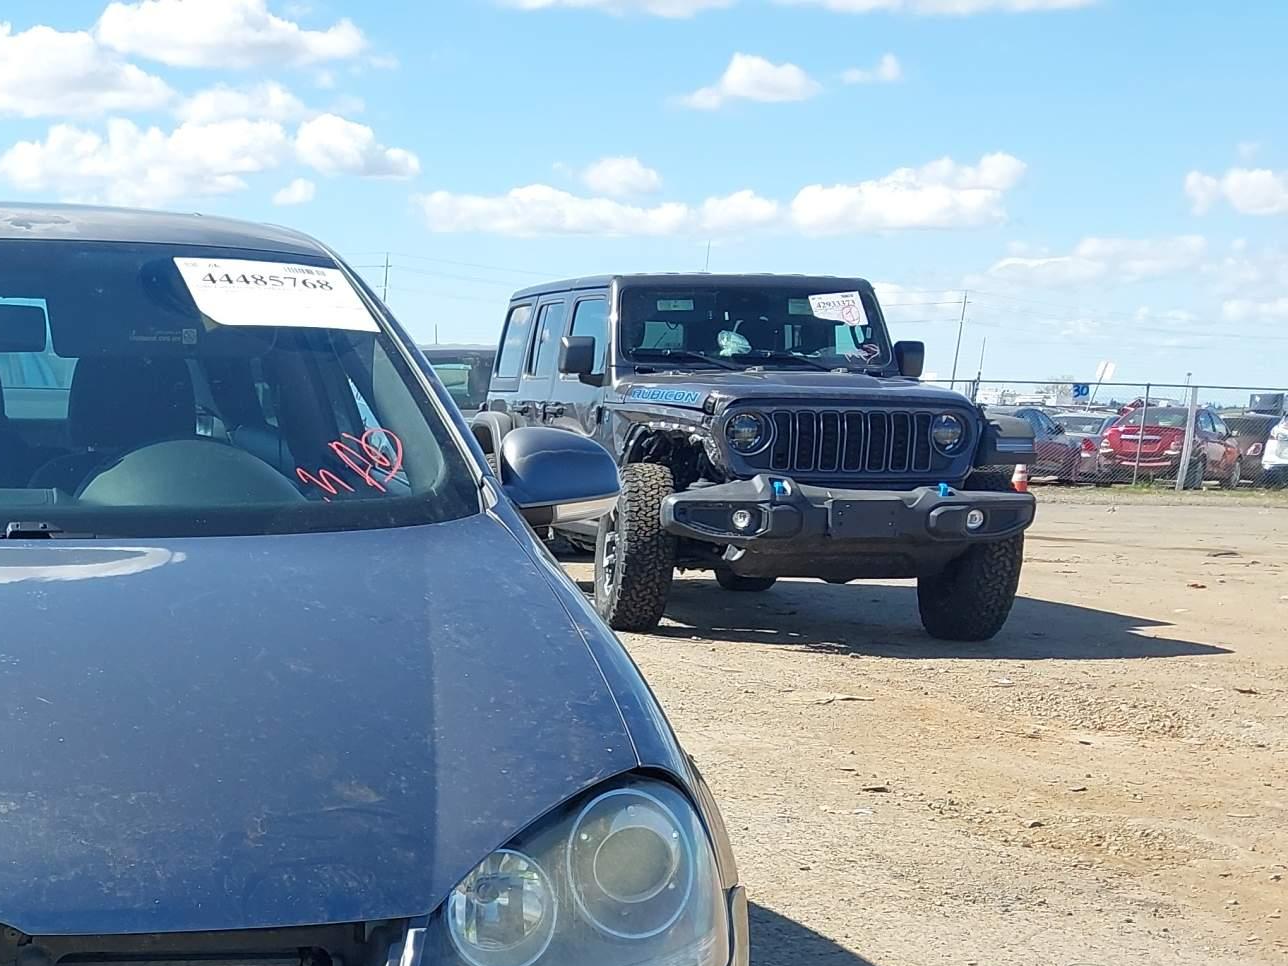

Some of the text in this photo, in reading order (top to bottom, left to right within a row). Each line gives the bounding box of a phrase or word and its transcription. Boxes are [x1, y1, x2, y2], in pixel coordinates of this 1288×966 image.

[202, 272, 333, 291] 44485768
[631, 388, 701, 404] RUBICON
[1072, 384, 1090, 398] 30
